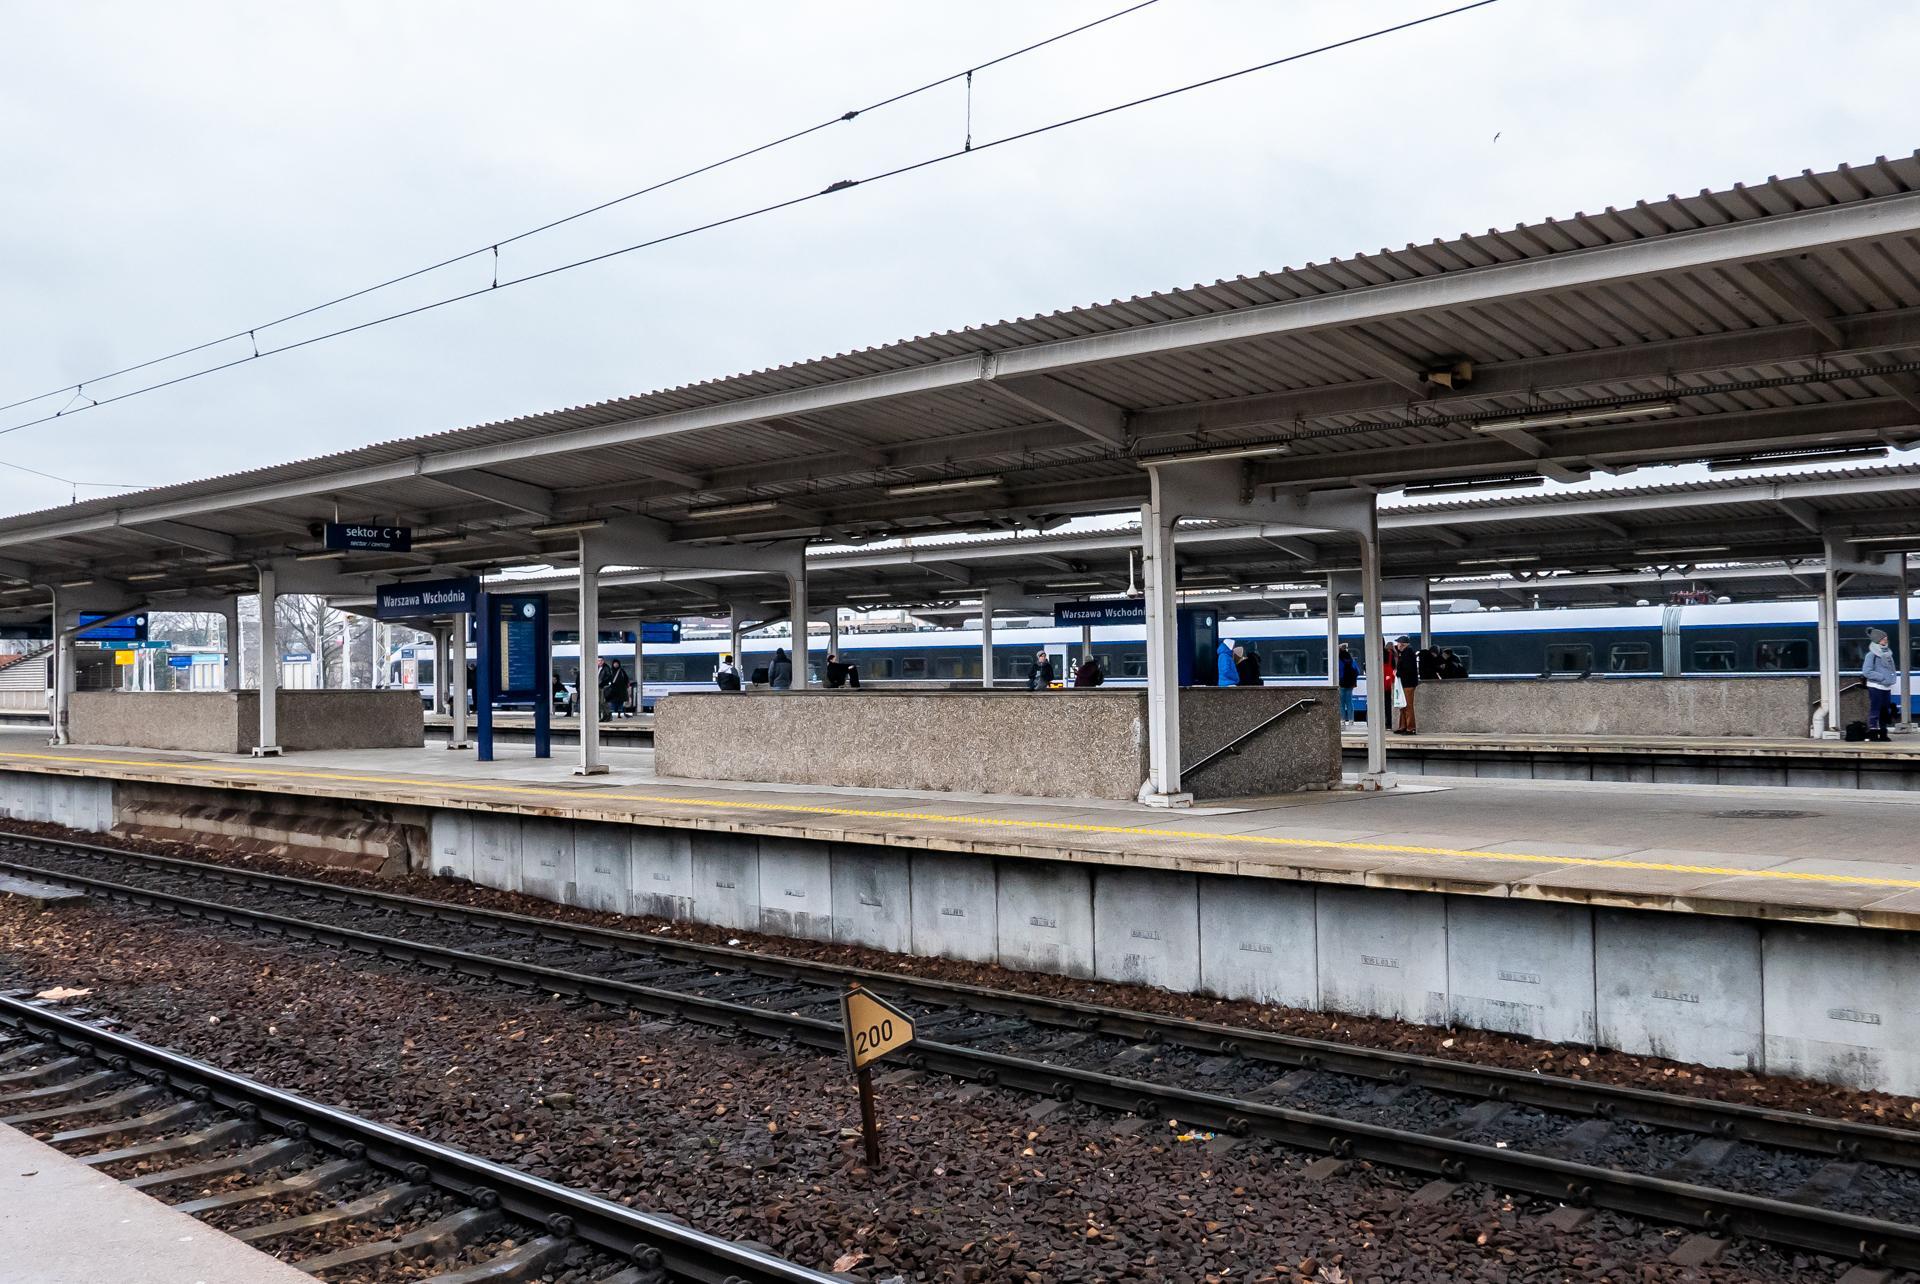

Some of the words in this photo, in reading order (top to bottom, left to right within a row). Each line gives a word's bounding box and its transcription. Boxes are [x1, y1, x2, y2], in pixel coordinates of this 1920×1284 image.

[346, 526, 378, 538] sektor
[383, 528, 391, 539] C
[383, 595, 420, 607] Warszawa
[422, 589, 466, 604] Wschodnia
[1062, 609, 1102, 619] Warszawa
[1105, 607, 1146, 617] Wschodni
[1072, 658, 1077, 667] 2
[856, 1019, 892, 1055] 200
